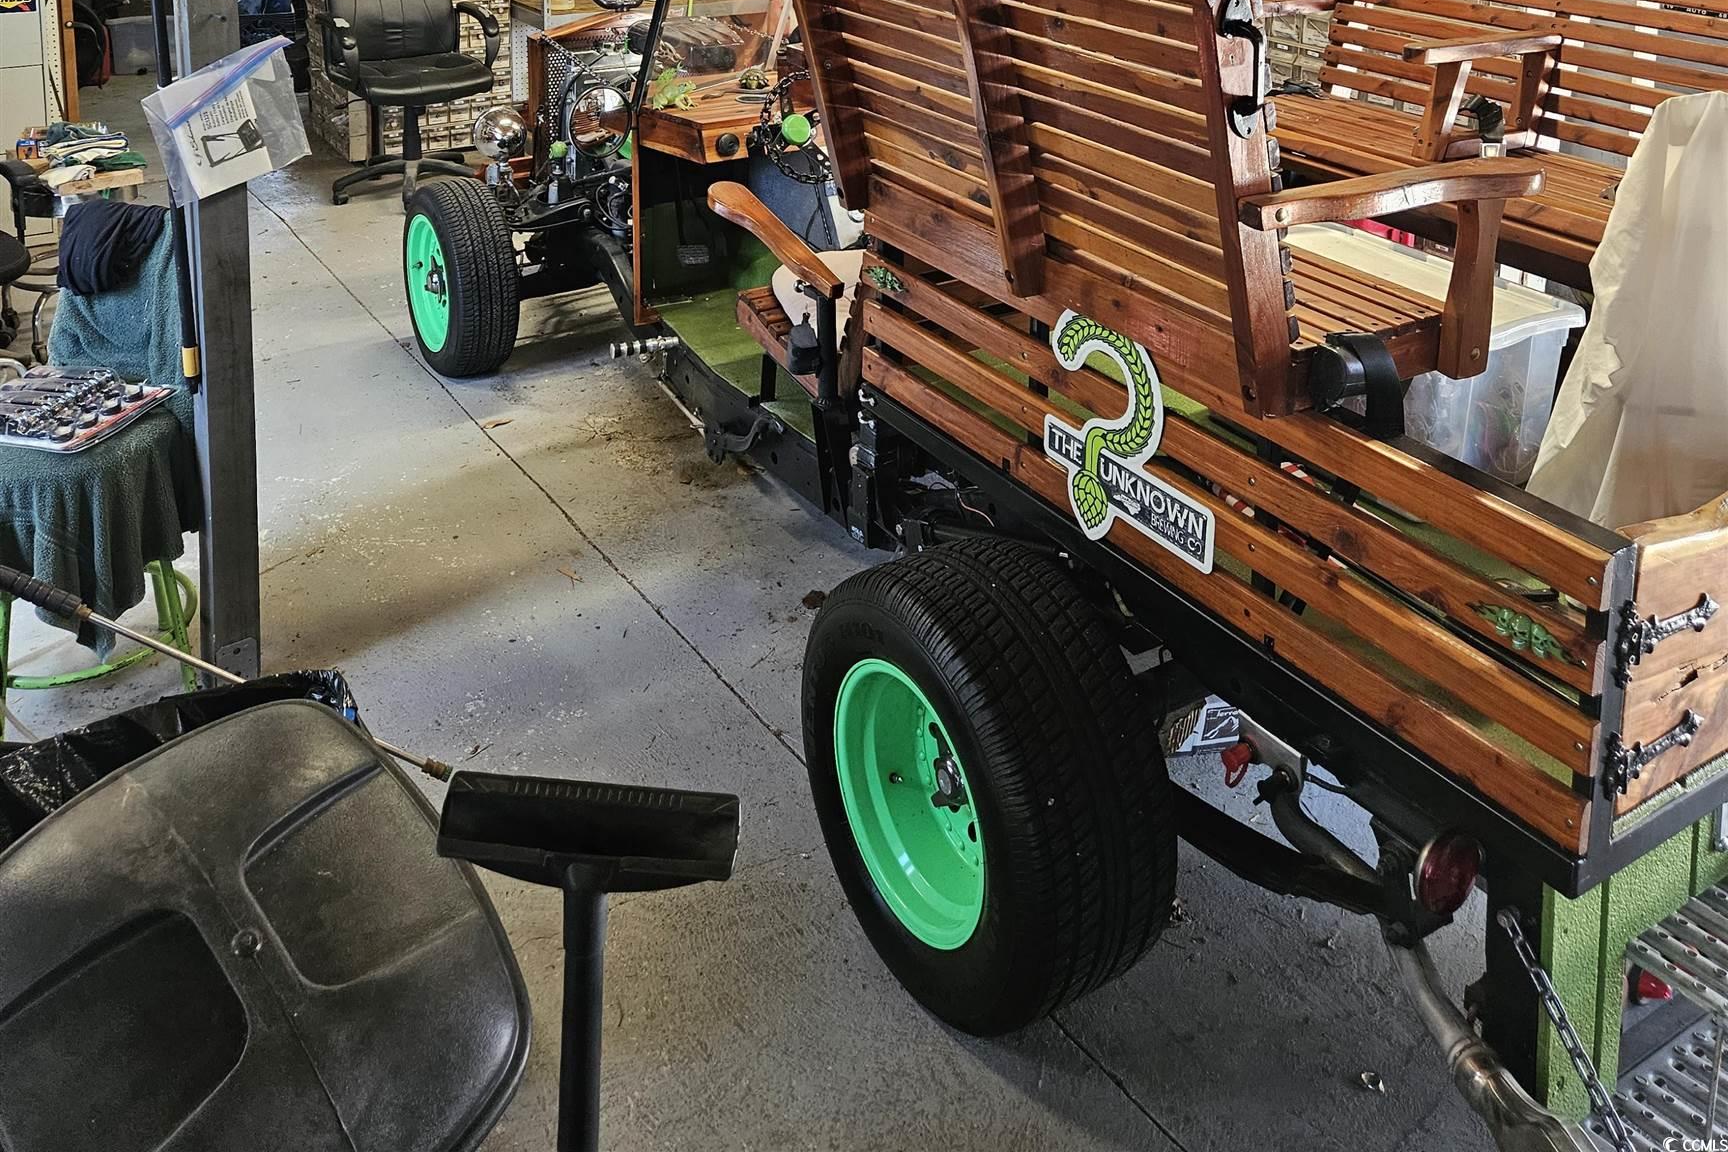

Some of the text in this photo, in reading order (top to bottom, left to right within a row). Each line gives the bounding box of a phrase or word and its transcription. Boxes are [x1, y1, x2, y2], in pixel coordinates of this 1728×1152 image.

[1052, 429, 1205, 539] THE UNKNOWN
[1151, 514, 1185, 546] BREWING
